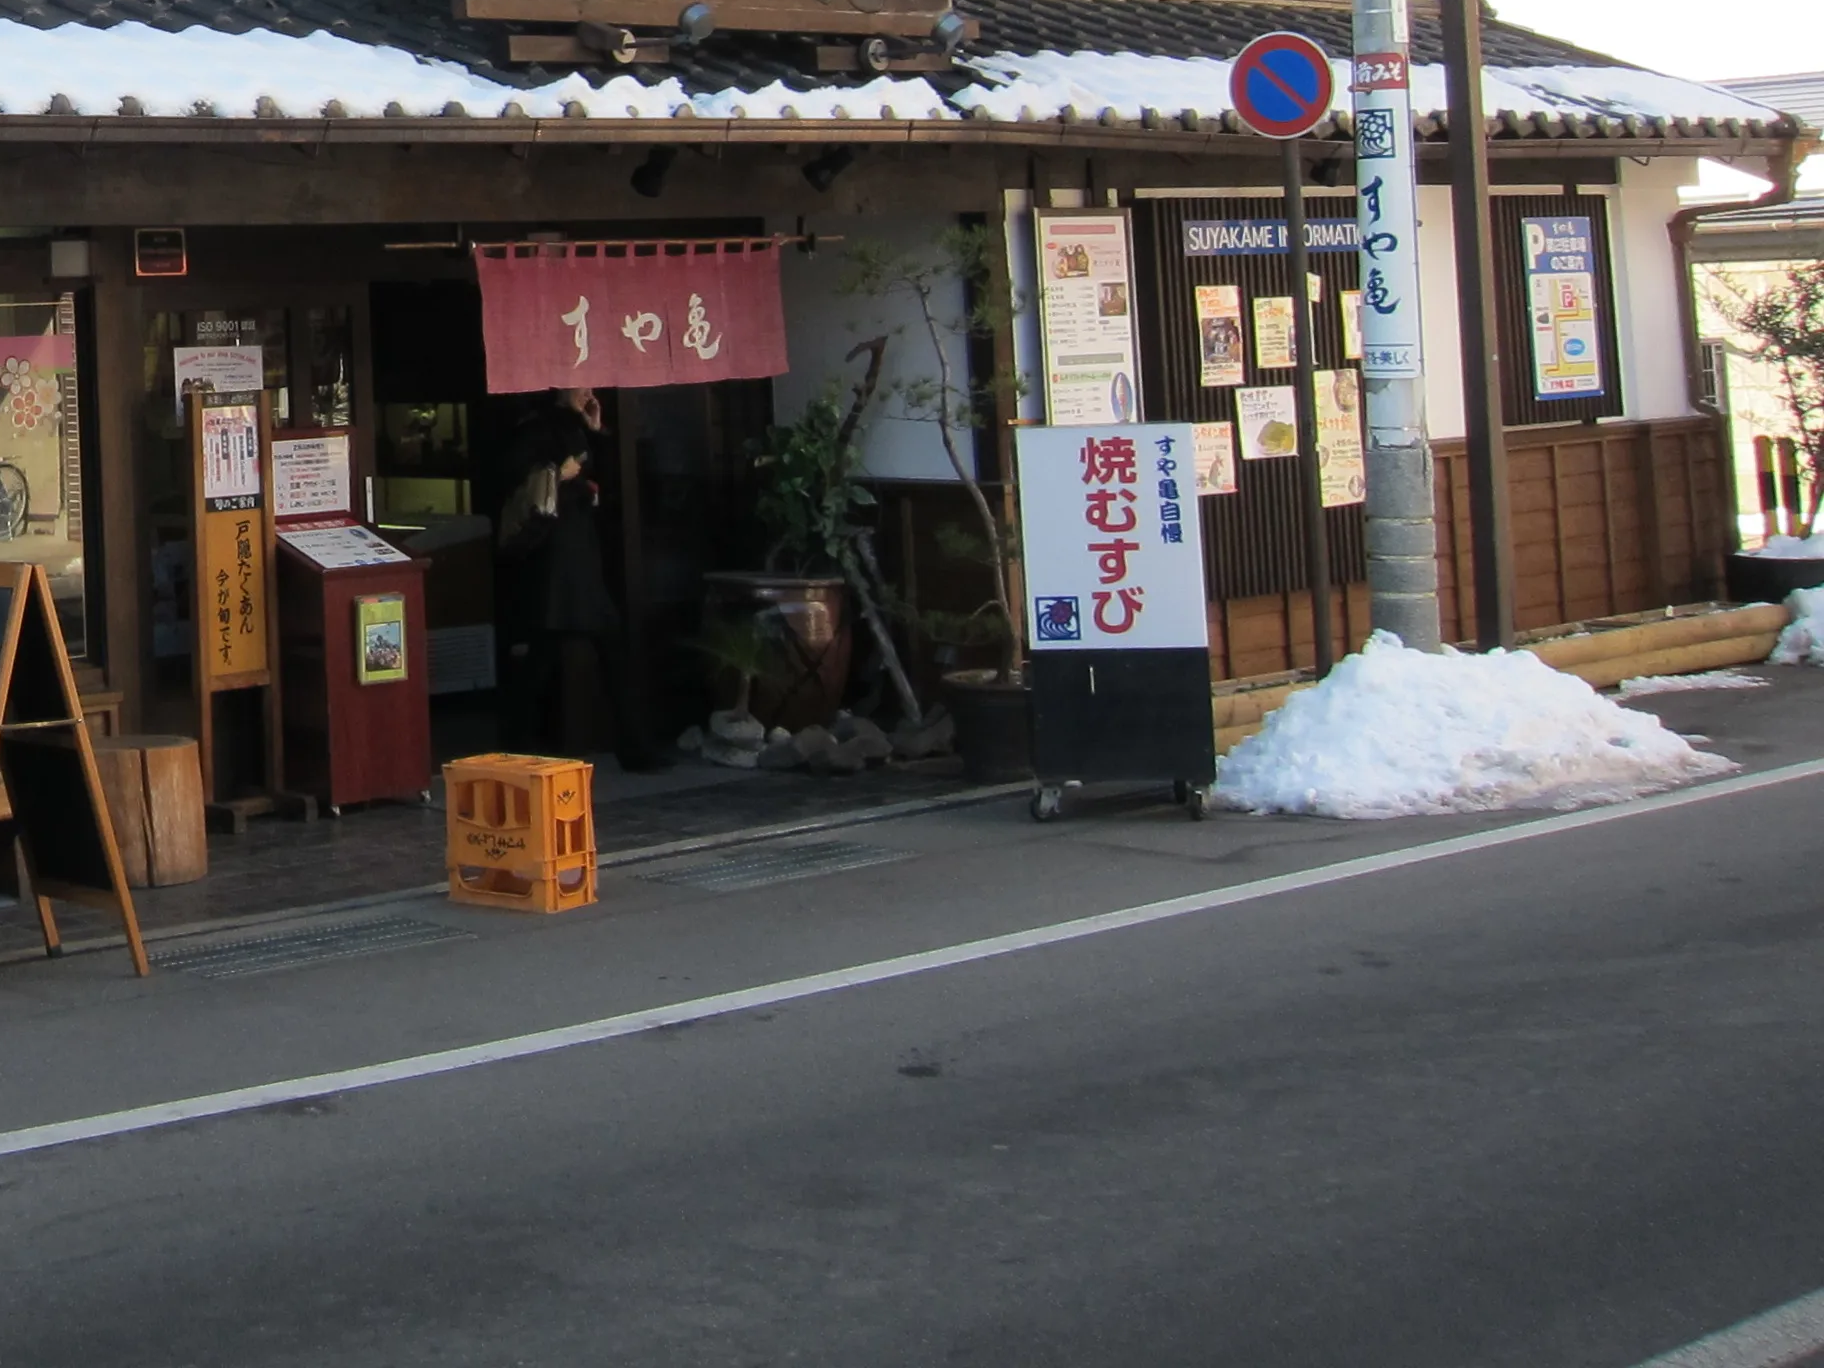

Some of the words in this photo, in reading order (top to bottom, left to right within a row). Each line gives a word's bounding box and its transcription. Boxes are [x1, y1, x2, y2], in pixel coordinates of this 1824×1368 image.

[1188, 225, 1275, 251] SUYAKAME
[1361, 176, 1401, 315] すや亀
[1526, 224, 1545, 269] P
[562, 293, 722, 367] すや亀
[1079, 436, 1144, 634] 焼むすび
[1154, 436, 1183, 544] すや亀自慢
[235, 520, 254, 635] 戸隠たくあん
